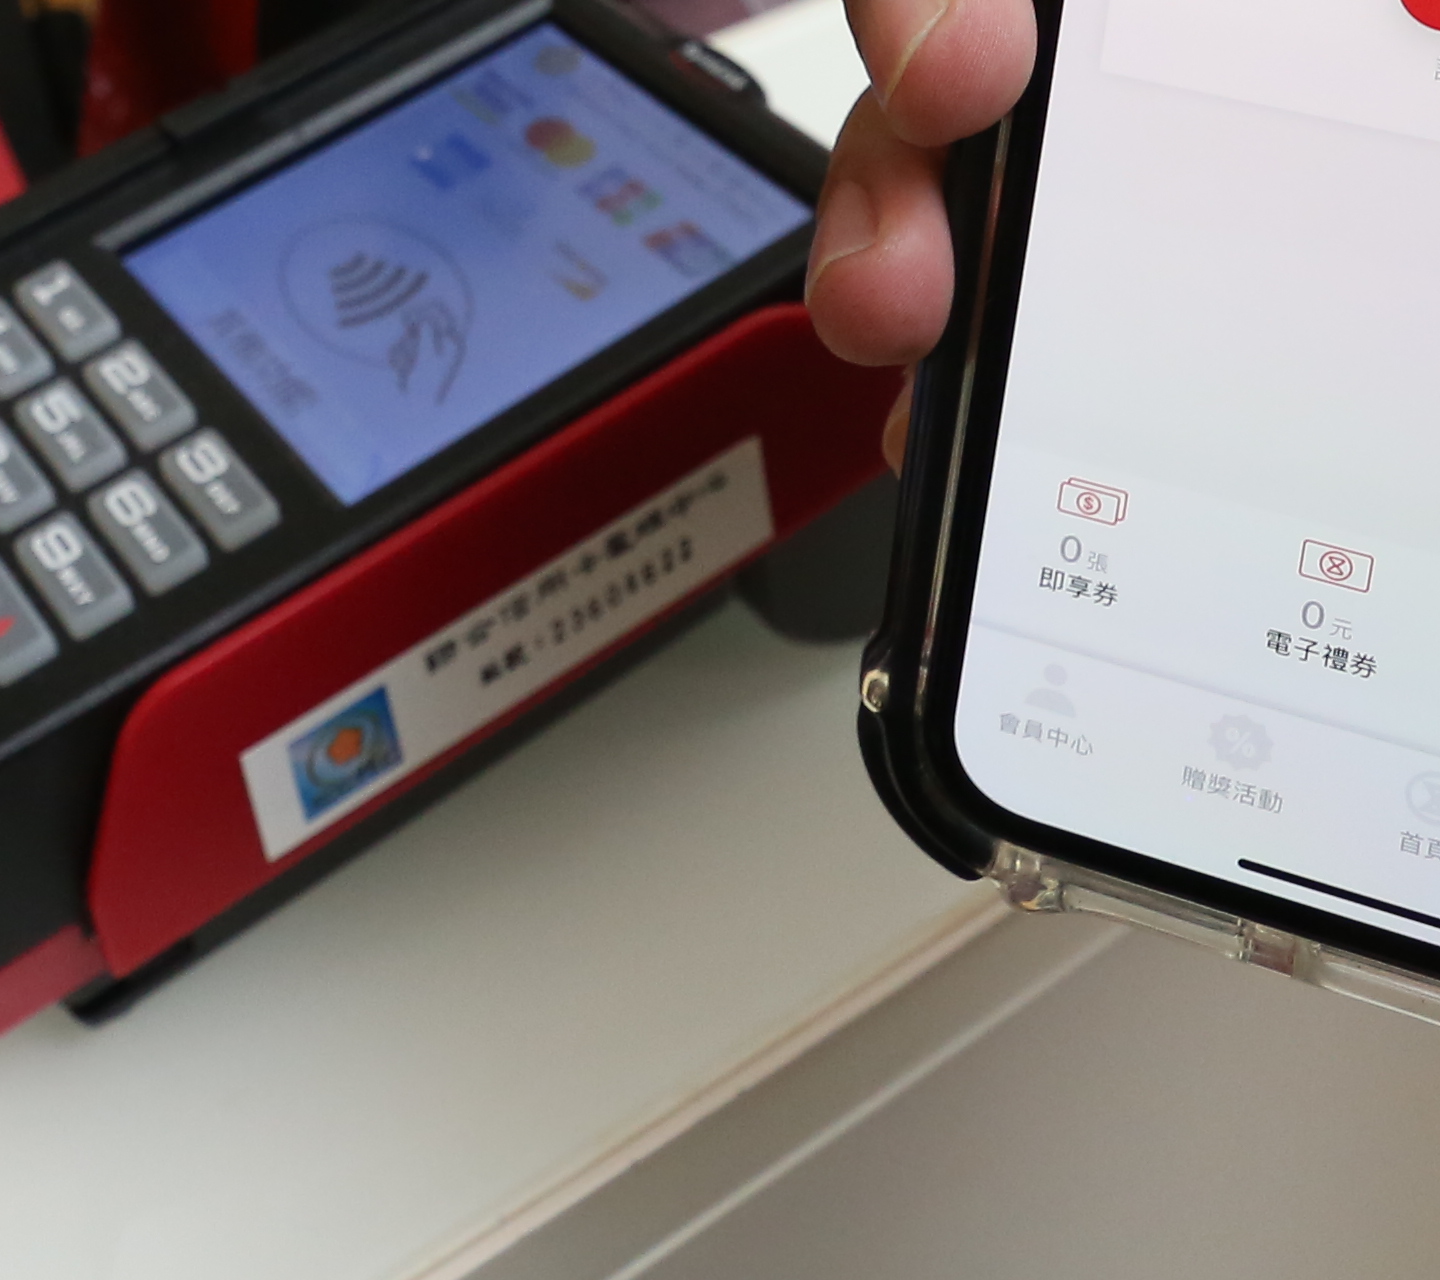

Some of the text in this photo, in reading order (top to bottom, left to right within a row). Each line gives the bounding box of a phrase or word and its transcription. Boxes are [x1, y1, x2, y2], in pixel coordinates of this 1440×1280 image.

[101, 354, 149, 394] 2
[32, 390, 80, 432] 5
[104, 480, 156, 525] 6
[1038, 567, 1117, 606] 即享券
[1267, 630, 1376, 678] 電子禮券
[1001, 714, 1092, 755] 會員中心
